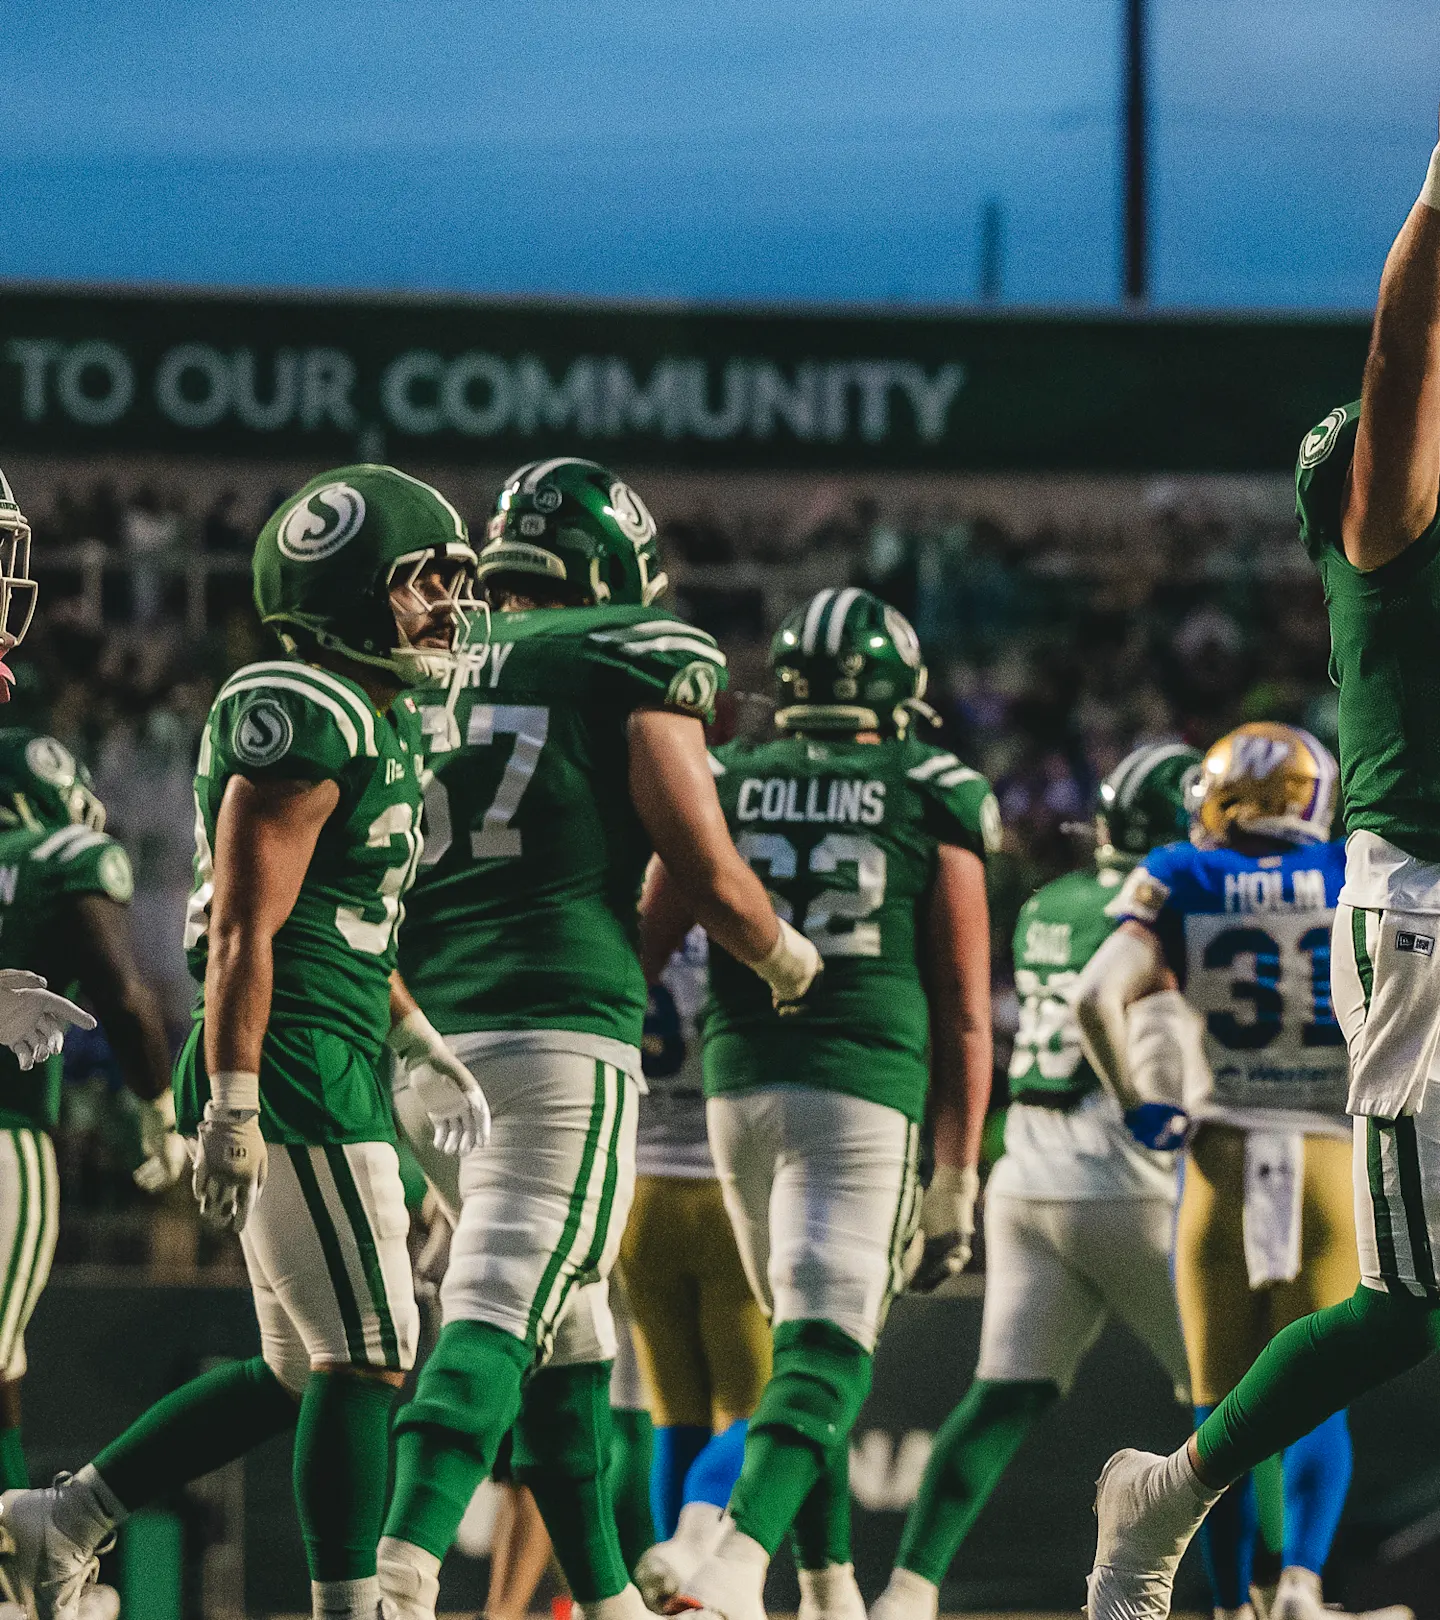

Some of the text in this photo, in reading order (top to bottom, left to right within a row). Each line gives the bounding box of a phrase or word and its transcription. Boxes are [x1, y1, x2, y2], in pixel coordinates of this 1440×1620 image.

[8, 337, 964, 442] TO OUR COMMUNITY
[736, 777, 887, 826] COLLINS
[1223, 869, 1326, 914] HOLM
[1203, 926, 1347, 1050] 31
